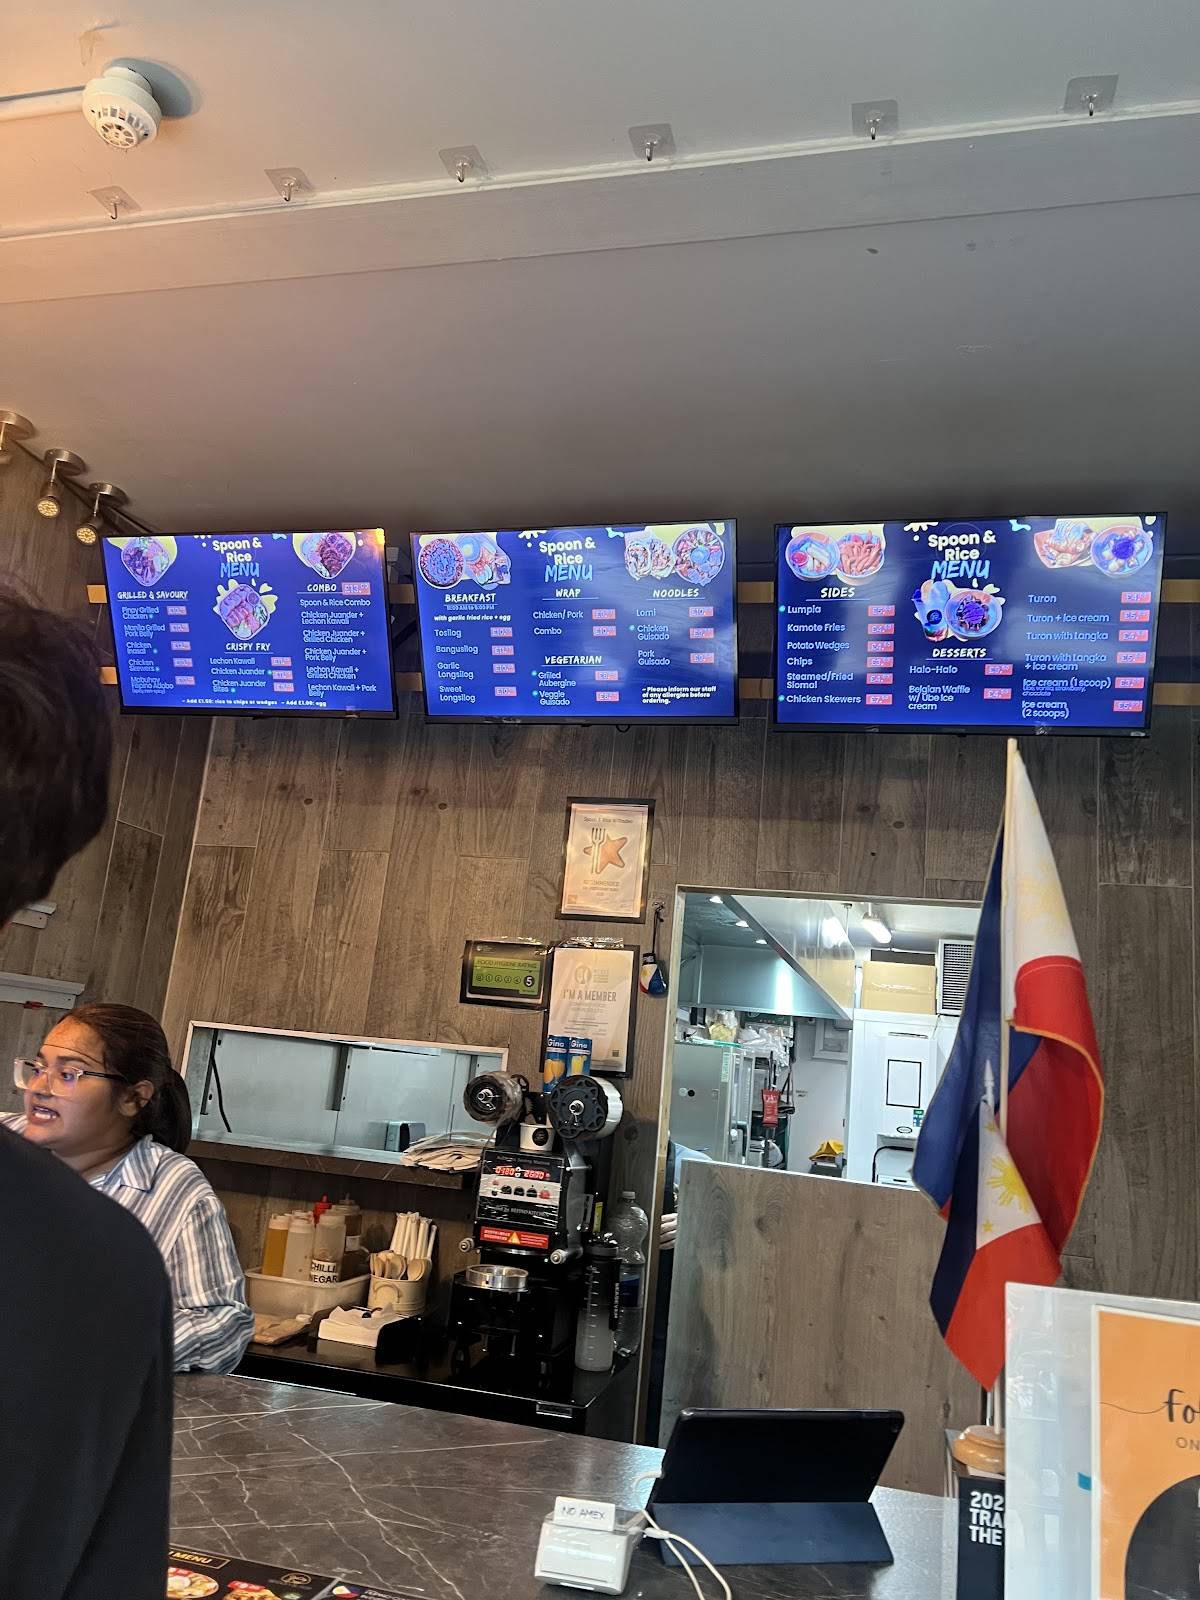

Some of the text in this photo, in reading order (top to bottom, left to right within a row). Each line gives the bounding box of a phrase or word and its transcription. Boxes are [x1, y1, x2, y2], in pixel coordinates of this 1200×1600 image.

[212, 537, 262, 554] Spoon &
[928, 530, 996, 551] Spoon &
[539, 537, 596, 556] Spoon &
[226, 551, 252, 563] Rice
[945, 546, 980, 561] Rice
[554, 552, 583, 566] Rice
[220, 562, 260, 578] MENU
[545, 564, 593, 583] MENU
[931, 560, 990, 580] MENU
[307, 583, 337, 592] COMBO
[820, 587, 855, 598] SIDES
[117, 591, 188, 600] GRILLED & SAVOURY
[445, 593, 496, 603] BREAKFAST
[556, 588, 581, 598] WRAP
[653, 588, 699, 598] NOODLES
[300, 599, 322, 608] Spoon
[329, 598, 343, 606] Rice
[344, 598, 371, 606] Combo
[1028, 595, 1057, 603] Turon
[533, 609, 584, 620] Chicken/ Pork
[636, 608, 656, 617] Lomi
[787, 604, 822, 615] Lumpia
[301, 611, 358, 619] Chicken Juander
[1027, 614, 1053, 622] Turon
[534, 627, 562, 635] Combo
[637, 624, 668, 633] Chicken
[787, 623, 846, 632] Kamote Fries
[303, 629, 359, 638] Chicken Juander
[434, 629, 462, 638] Tosilog
[637, 633, 669, 641] Guisado
[1026, 631, 1109, 642] Turon with Langka
[226, 642, 271, 652] CRISPY FRY
[435, 645, 478, 655] Bangusilog
[787, 641, 850, 652] Potato Wedges
[304, 648, 361, 656] Chicken Juander
[638, 650, 655, 658] Pork
[932, 648, 987, 658] DESSERTS
[210, 657, 233, 665] Lechon
[545, 655, 602, 665] VEGETARIAN
[787, 657, 813, 667] Chips
[1025, 653, 1107, 663] Turon with Langka
[211, 667, 265, 675] Chicken Juander
[909, 665, 958, 674] Halo-Halo
[438, 671, 474, 680] Longsilog
[538, 671, 561, 679] Grilled
[787, 671, 854, 682] Steamed/Fried
[212, 679, 238, 687] Chicken
[539, 679, 576, 689] Aubergine
[787, 680, 818, 689] Siomai
[1038, 679, 1069, 687] cream
[1070, 677, 1078, 689] (1
[1078, 677, 1111, 689] scoop)
[440, 685, 462, 693] Sweet
[909, 685, 971, 695] Belgian Waffle
[440, 694, 476, 703] Longsilog
[539, 690, 565, 700] Veggie
[662, 691, 689, 700] allergies
[786, 694, 861, 703] Chicken Skewers
[922, 694, 940, 702] Ube
[540, 698, 570, 706] Guisado
[642, 697, 671, 705] ordering.
[1022, 708, 1069, 719] (2 scoops)
[526, 976, 533, 987] 5
[563, 989, 617, 1002] I'M A MEMBER
[313, 1275, 337, 1284] EGAR
[1164, 1388, 1200, 1424] fo
[970, 1490, 1004, 1512] 202
[562, 1506, 606, 1520] NO AMEX
[969, 1507, 1004, 1528] TRA
[968, 1525, 1003, 1546] THE
[172, 1552, 213, 1564] MENU
